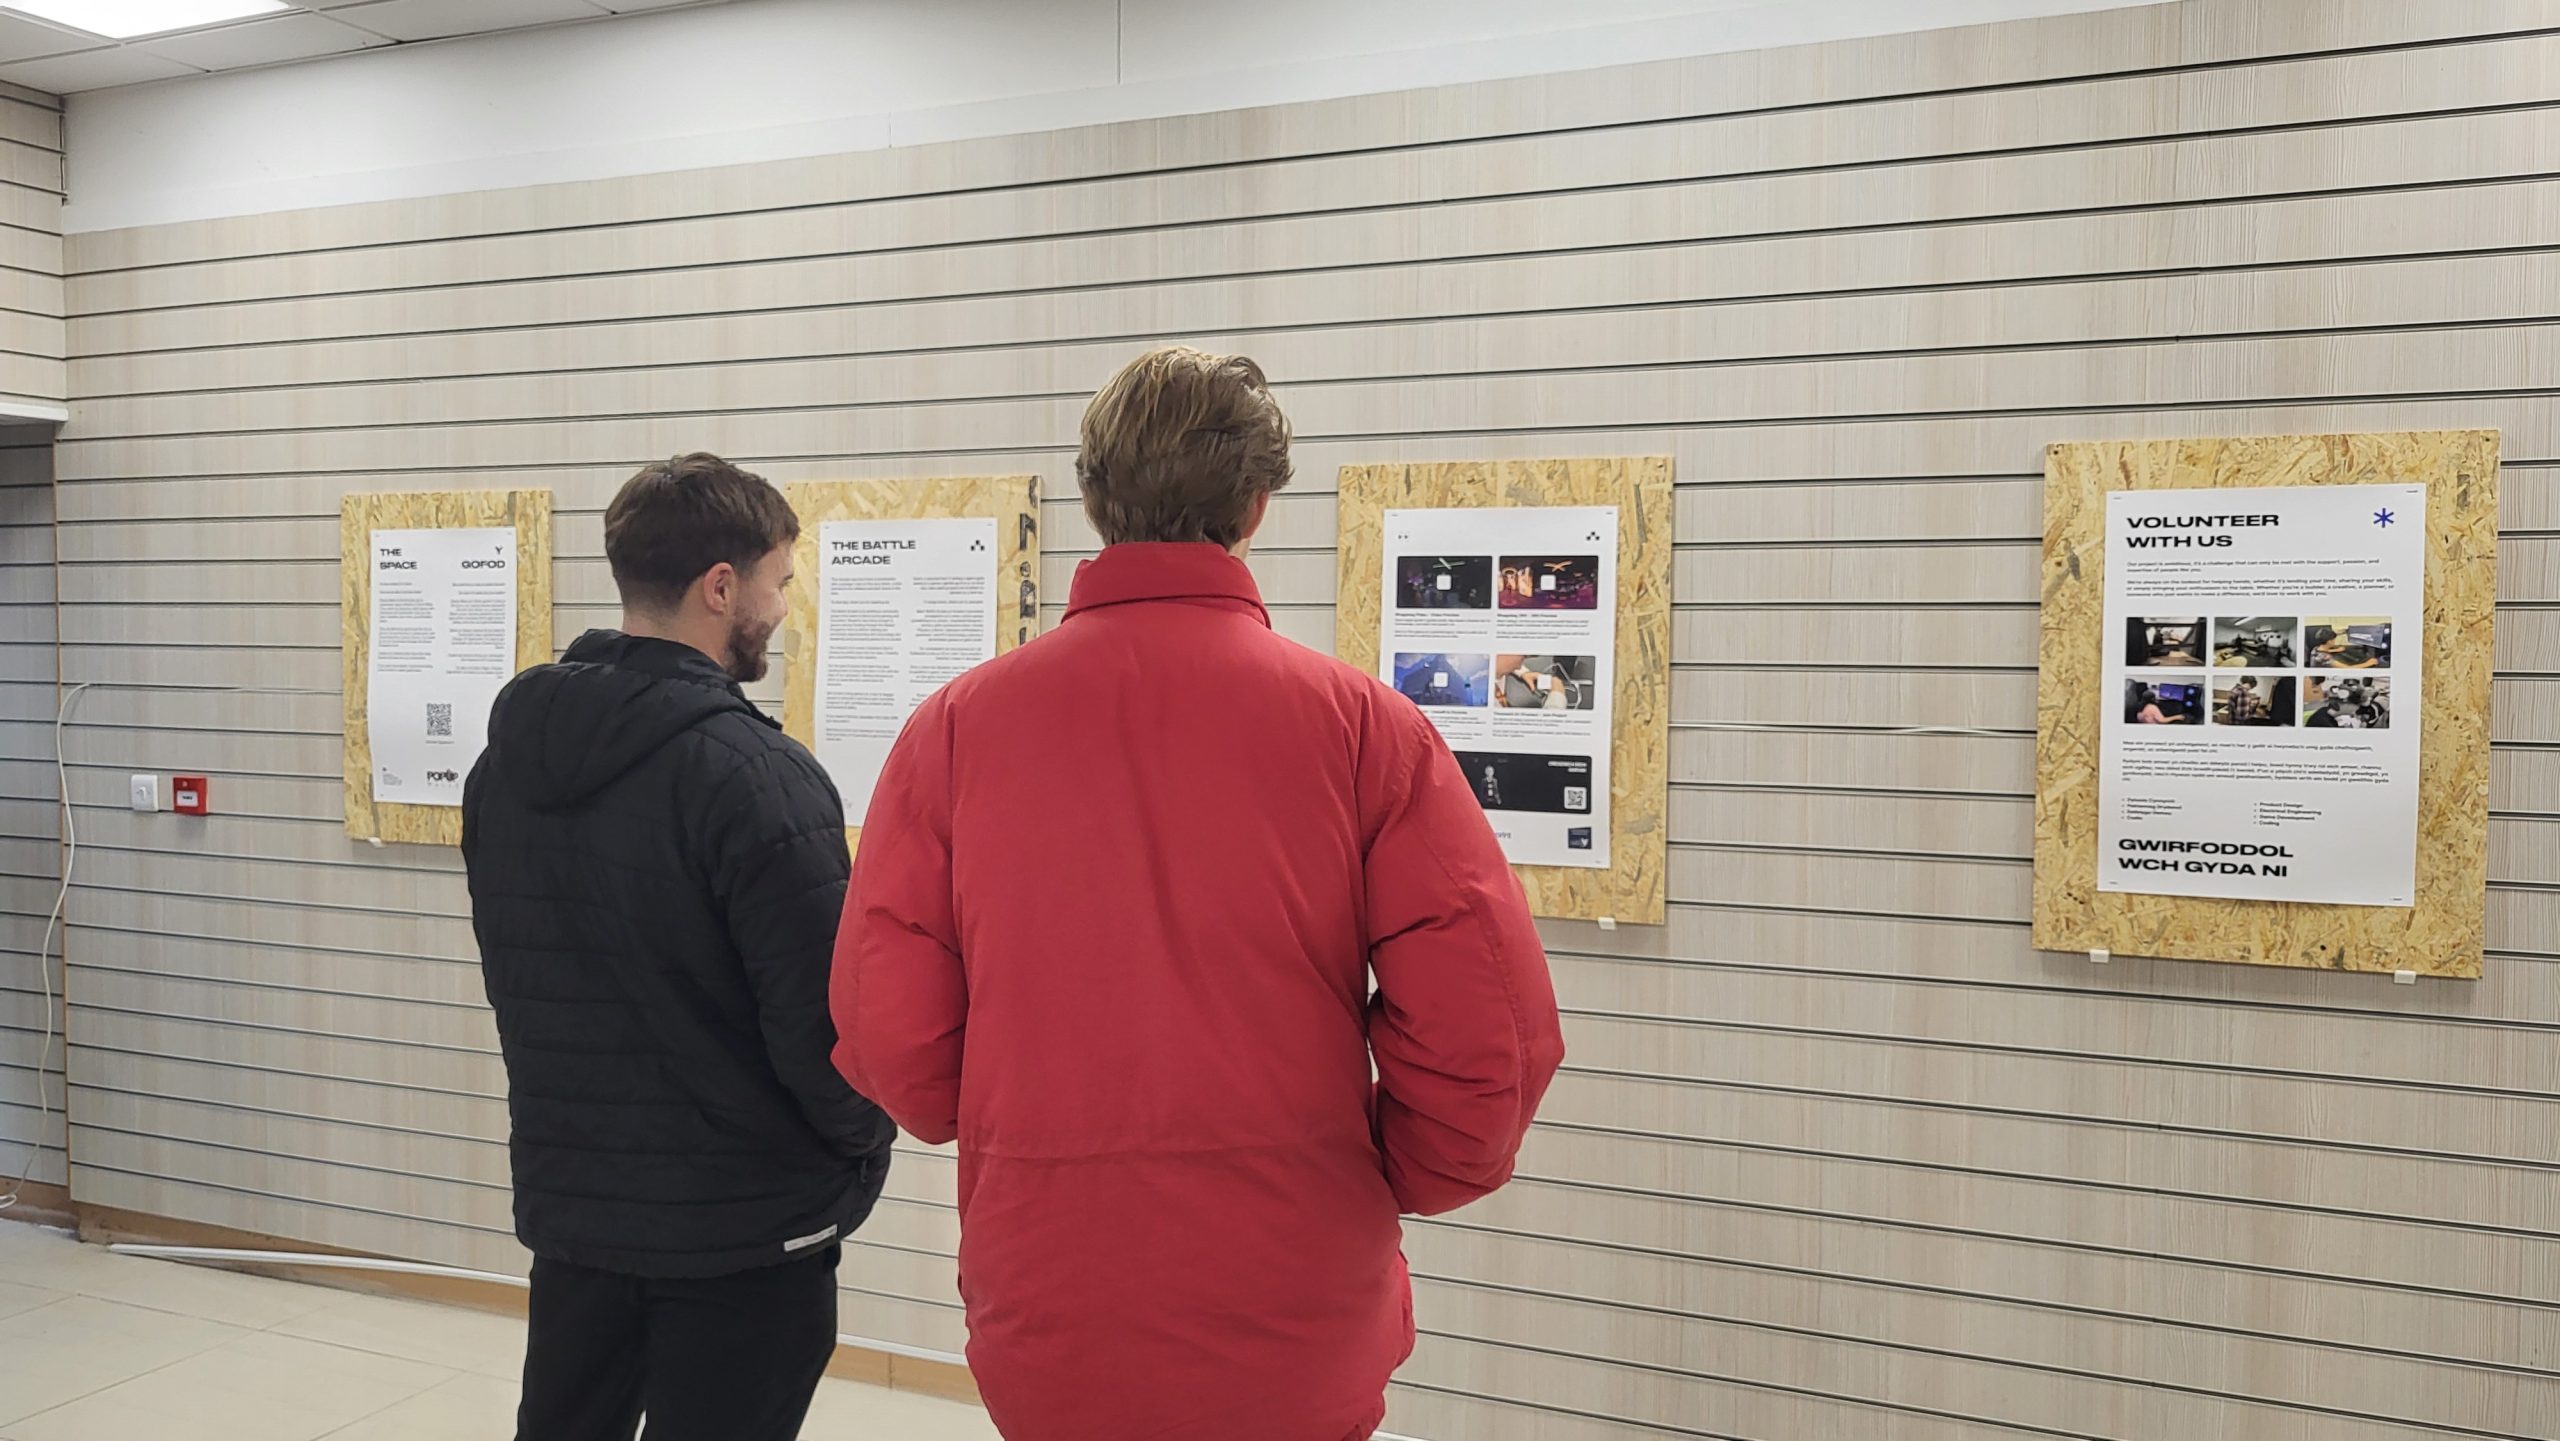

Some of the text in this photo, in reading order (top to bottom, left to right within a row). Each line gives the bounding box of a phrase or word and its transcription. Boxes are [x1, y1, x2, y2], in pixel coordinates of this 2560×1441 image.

[2126, 514, 2280, 529] VOLUNTEER
[831, 540, 916, 551] THE BATTLE
[2126, 535, 2233, 548] WITH US
[380, 548, 402, 557] THE
[495, 546, 504, 555] Y
[379, 561, 418, 570] SPACE
[461, 560, 506, 569] GOFOD
[831, 555, 891, 566] ARCADE
[2118, 838, 2294, 858] GWIRFODDOL
[2118, 857, 2287, 877] WCH GYDA NI
